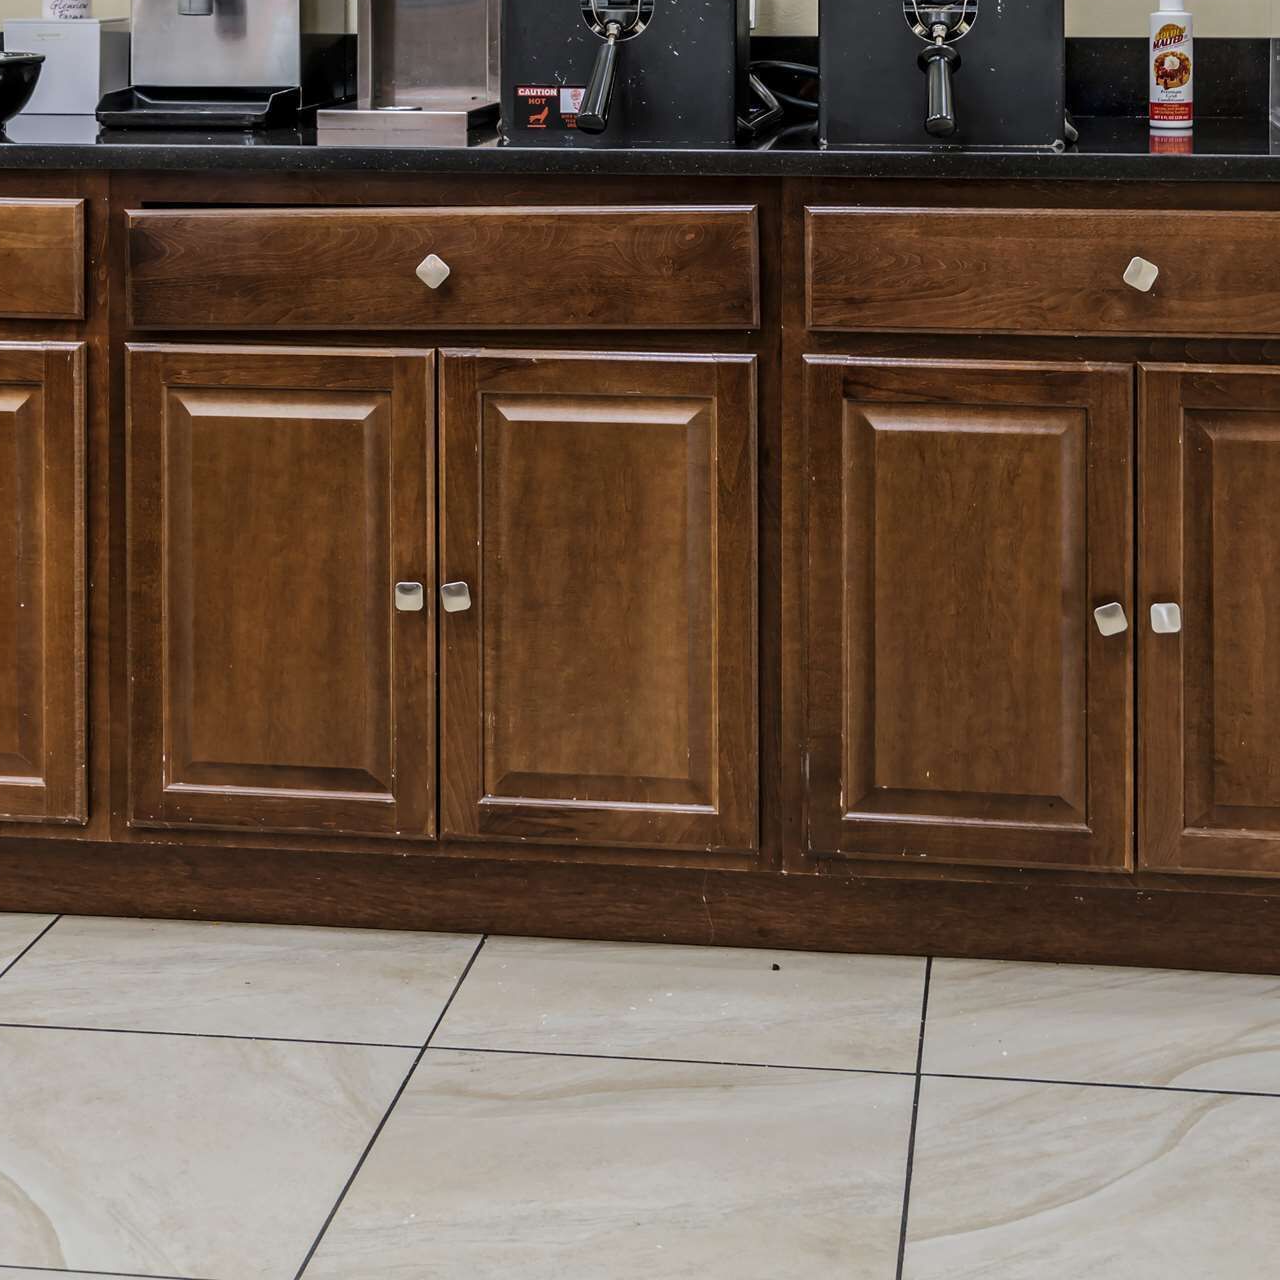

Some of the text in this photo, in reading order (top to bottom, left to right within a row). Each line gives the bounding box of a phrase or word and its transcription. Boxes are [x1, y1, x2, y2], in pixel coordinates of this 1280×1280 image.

[1153, 35, 1184, 51] MALTED
[517, 88, 558, 96] CAUTION
[528, 97, 546, 105] HOT
